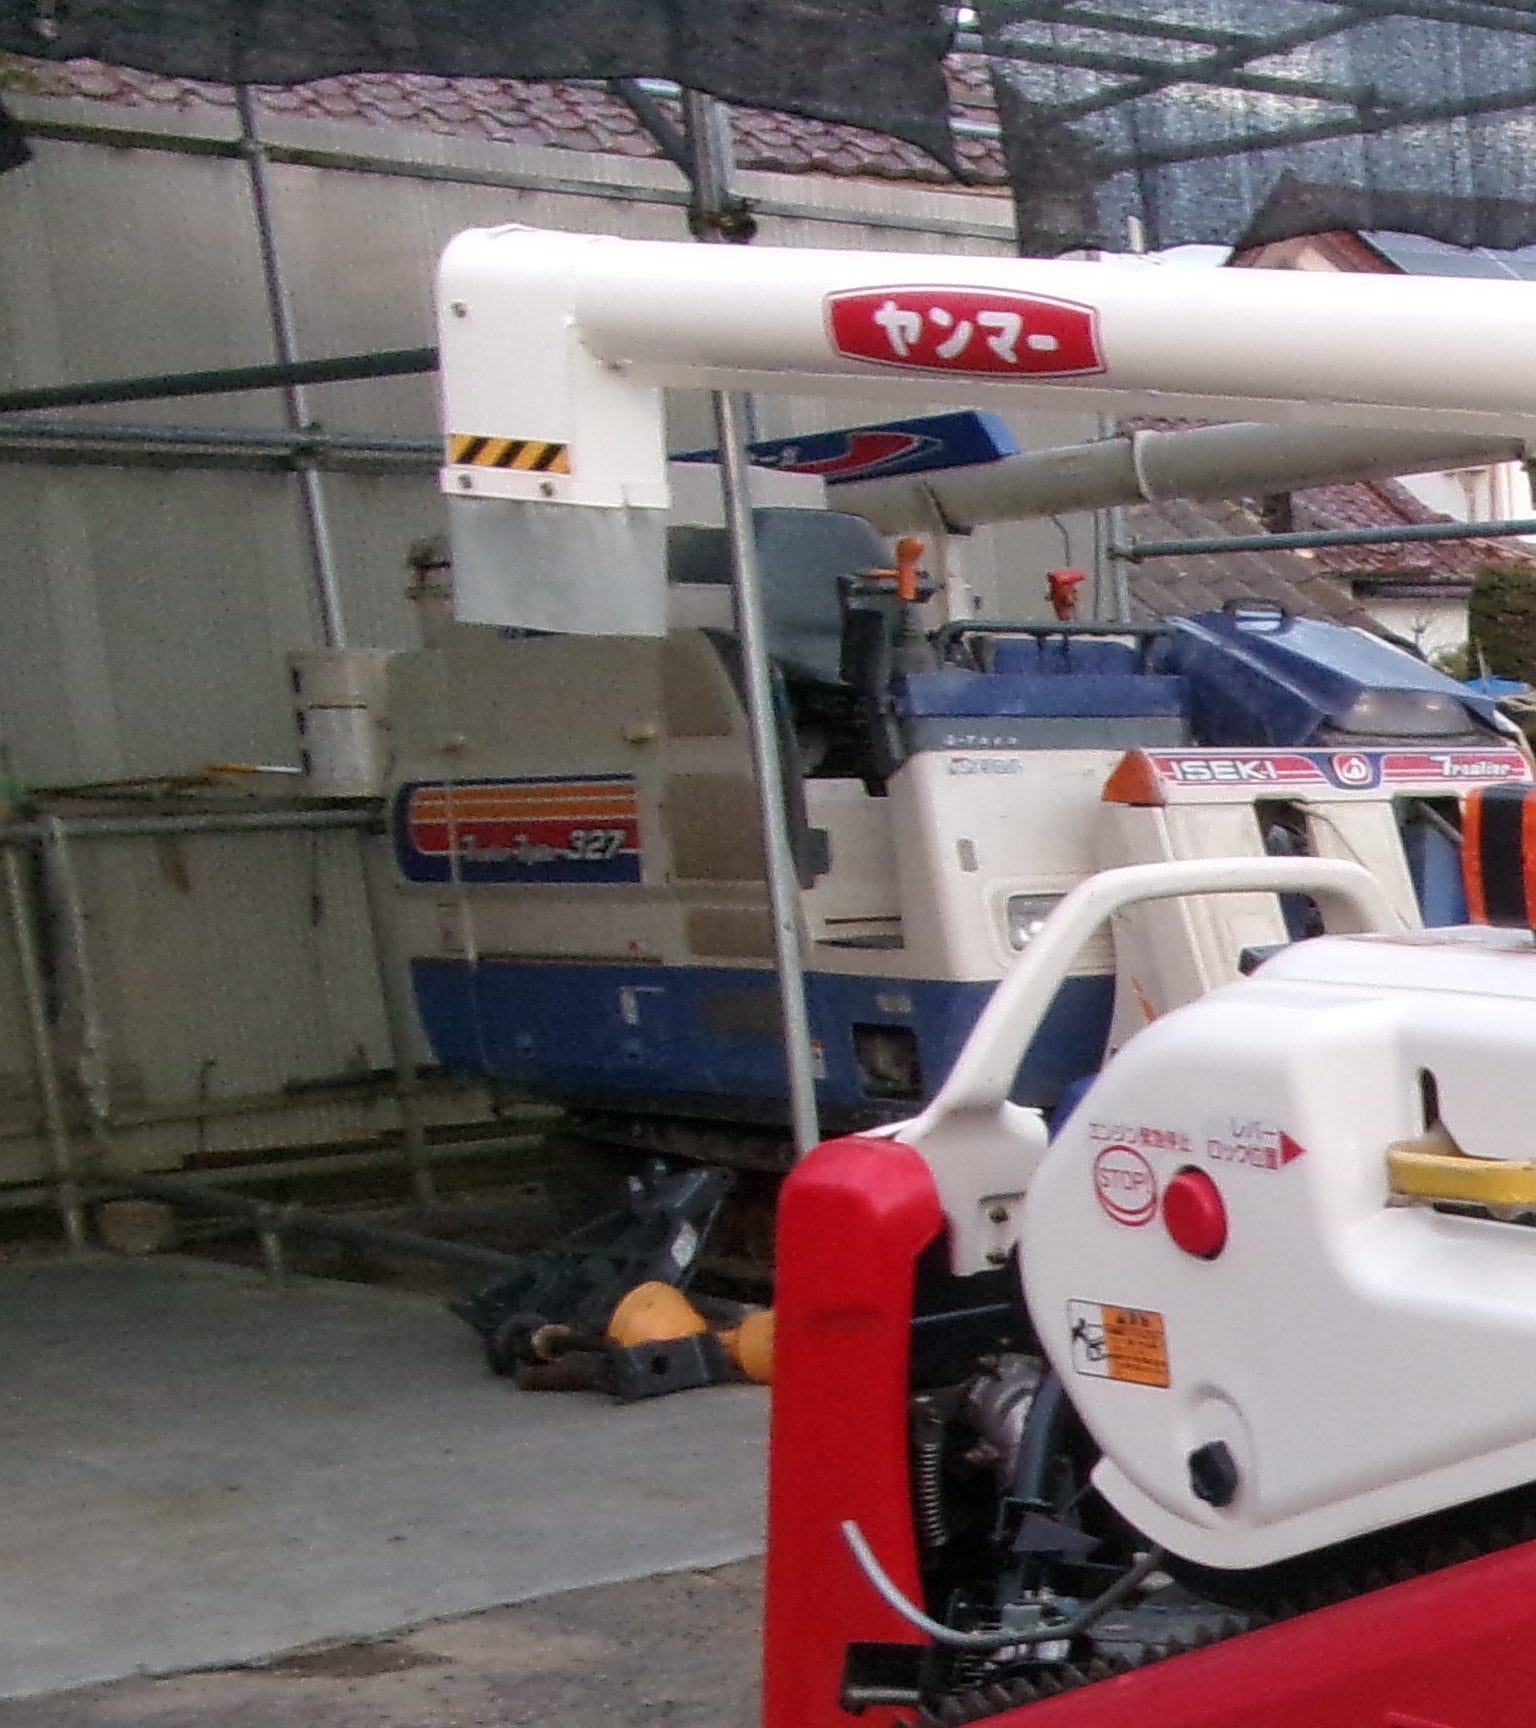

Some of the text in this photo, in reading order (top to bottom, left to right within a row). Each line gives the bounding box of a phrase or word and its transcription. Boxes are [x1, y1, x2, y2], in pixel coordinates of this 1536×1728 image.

[874, 300, 1059, 364] ヤンマー
[1169, 760, 1278, 781] ISEKI
[571, 829, 628, 860] 327
